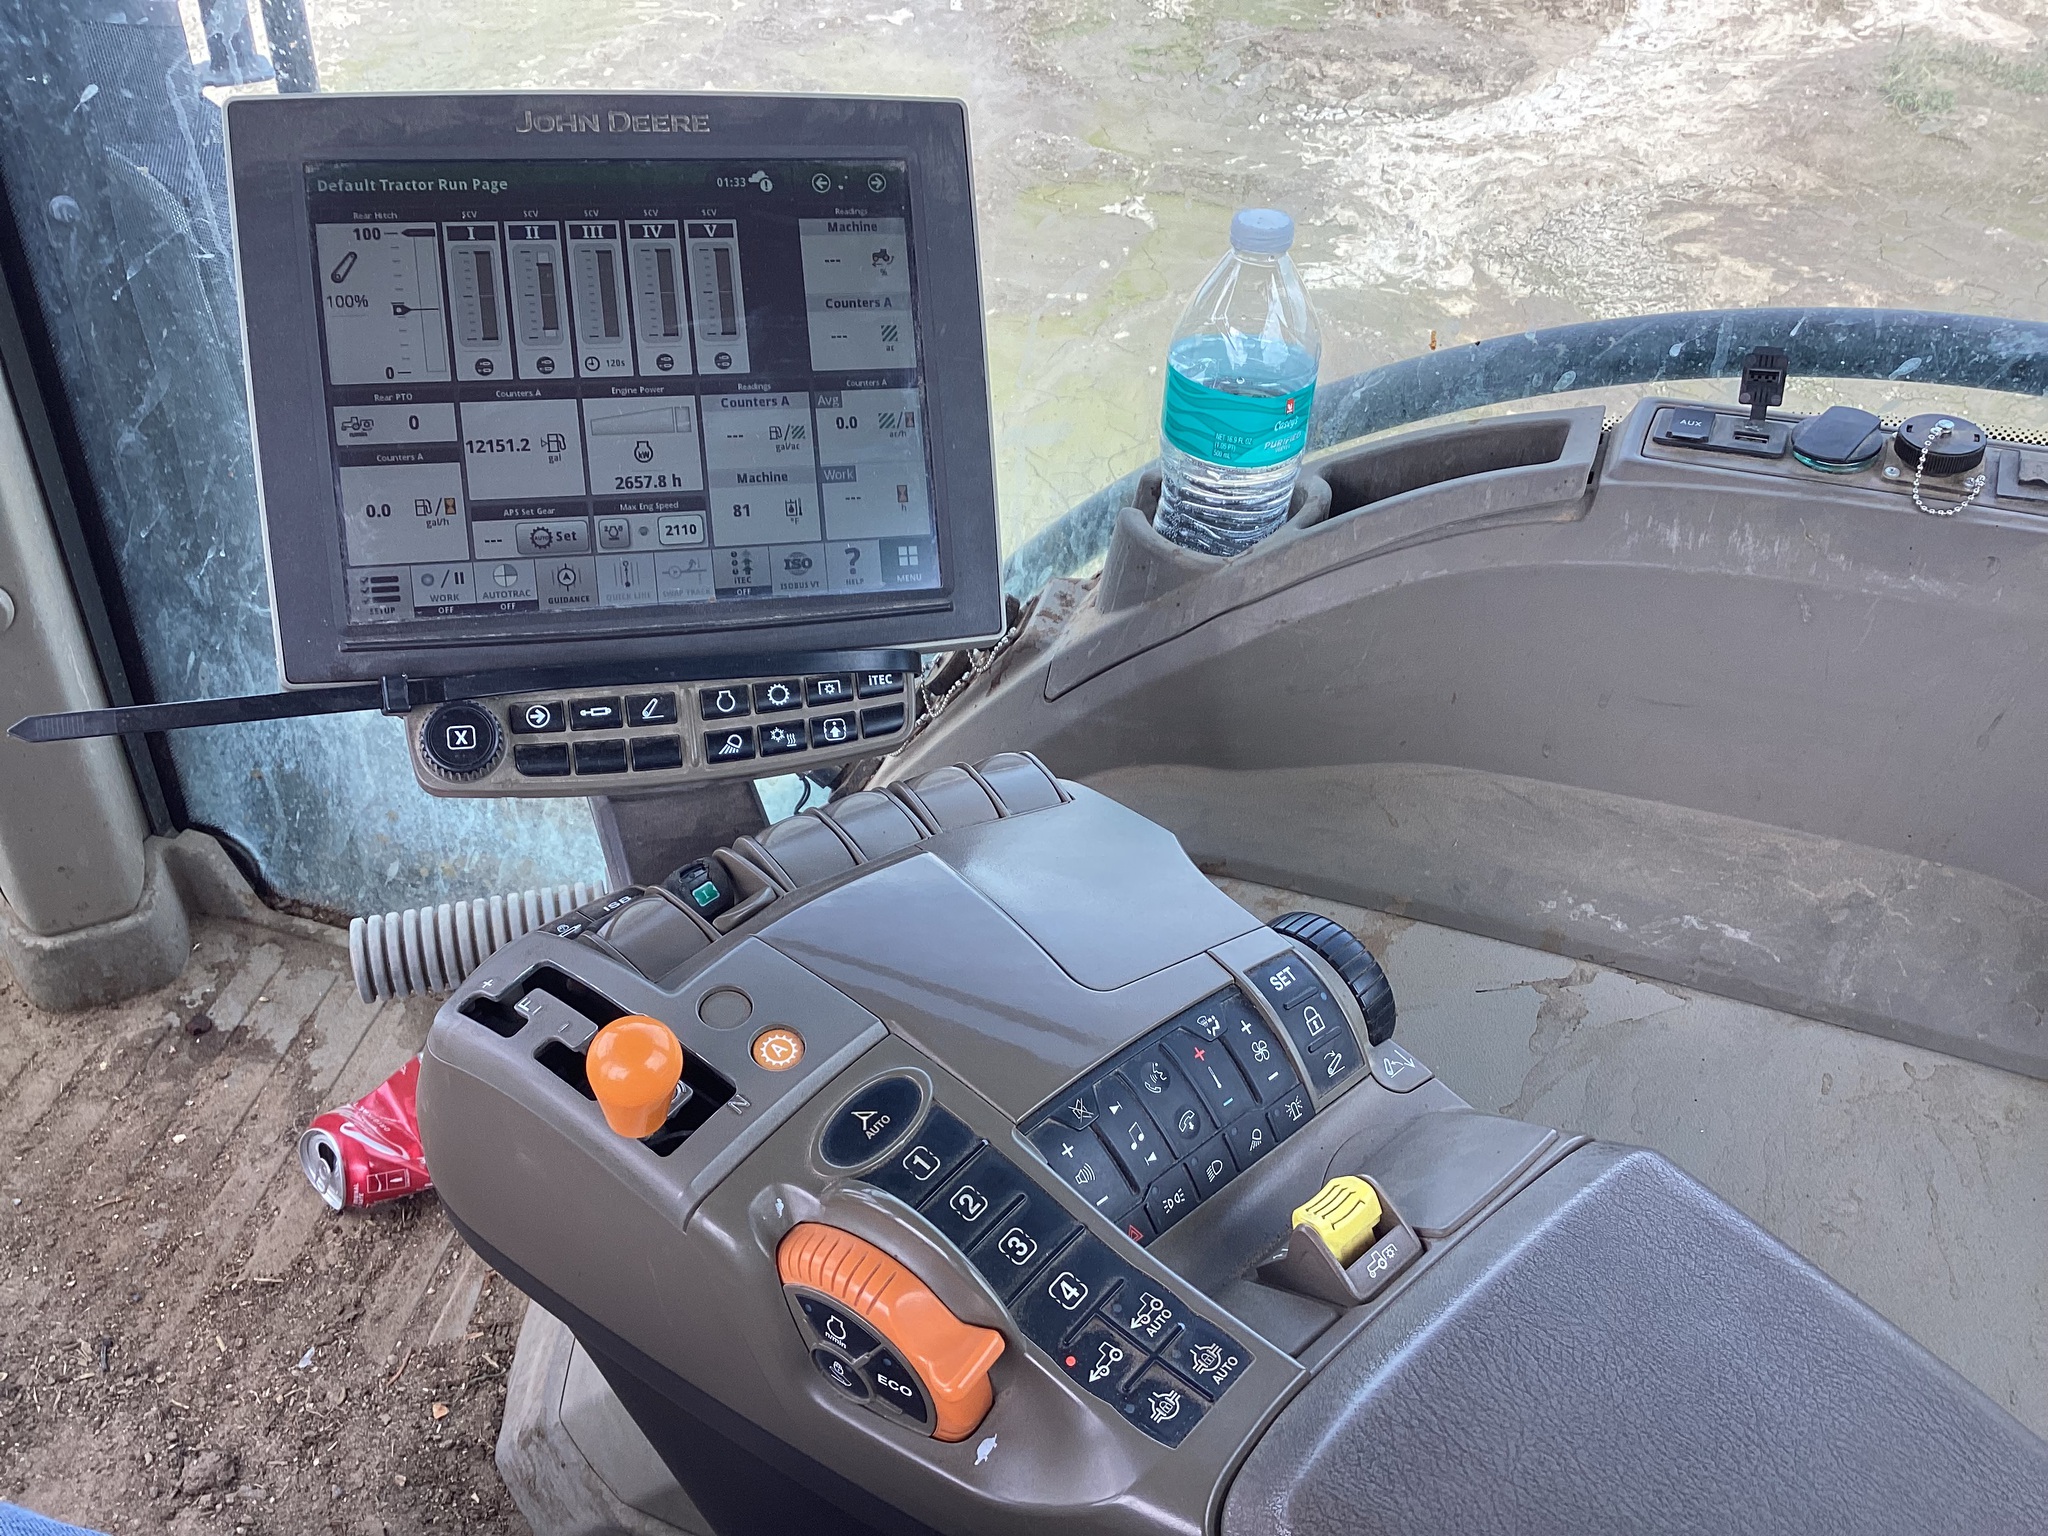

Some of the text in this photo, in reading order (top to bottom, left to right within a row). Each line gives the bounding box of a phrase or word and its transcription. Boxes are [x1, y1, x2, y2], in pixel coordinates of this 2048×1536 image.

[515, 110, 711, 133] JOHN DEERE
[317, 178, 508, 194] Default Tractor Run Page
[716, 177, 746, 188] 01:33
[353, 210, 398, 221] Rear Hitch
[461, 210, 477, 218] SCV
[523, 210, 539, 218] SCV
[584, 209, 600, 217] SCV
[643, 209, 659, 217] SCV
[702, 208, 718, 216] SCV
[835, 207, 868, 217] Readings
[582, 225, 604, 238] III
[642, 225, 662, 239] IV
[703, 224, 717, 237] V
[827, 222, 878, 233] Machine
[353, 228, 381, 241] 100
[327, 295, 369, 309] 100%
[825, 297, 892, 309] Counters A
[606, 358, 626, 368] 120s
[386, 367, 394, 379] 0
[846, 379, 879, 387] Counters
[496, 390, 533, 398] Counters
[611, 385, 665, 396] Engine Power
[374, 393, 413, 402] Rear PTO
[721, 396, 790, 408] Counters A
[817, 394, 840, 408] Avg
[408, 415, 419, 430] 0
[835, 416, 858, 430] 0.0
[1680, 418, 1702, 428] AUX
[465, 438, 531, 453] 12151.2
[376, 453, 424, 463] Counters A
[548, 453, 562, 464] gal
[1213, 449, 1223, 457] 500
[736, 472, 788, 484] Machine
[823, 468, 854, 481] Work
[615, 473, 682, 490] 2657.8 h
[365, 504, 392, 518] 0.0
[503, 507, 555, 517] APS Set Gear
[620, 501, 679, 512] Max Eng Speed
[733, 504, 750, 517] 81
[665, 524, 697, 536] 2110
[556, 531, 577, 542] Set
[784, 557, 812, 570] ISO
[845, 578, 865, 586] HELP
[897, 574, 922, 583] MENU
[430, 593, 460, 602] WORK
[482, 589, 531, 600] AUTOTRAC
[548, 595, 590, 604] GUIDANCE
[438, 606, 454, 615] OFF
[500, 602, 516, 611] OFF
[454, 730, 468, 745] X
[603, 896, 632, 912] ISB
[1269, 966, 1296, 991] SET
[771, 1041, 785, 1056] A
[728, 1094, 751, 1115] N
[865, 1114, 892, 1141] AUTO
[911, 1153, 931, 1172] 1
[959, 1192, 982, 1215] 2
[1007, 1236, 1029, 1257] 3
[1059, 1278, 1080, 1302] 4
[1144, 1308, 1173, 1338] AUTO
[825, 1331, 847, 1349] n/min
[1211, 1355, 1239, 1385] AUTO
[877, 1373, 913, 1397] ECO
